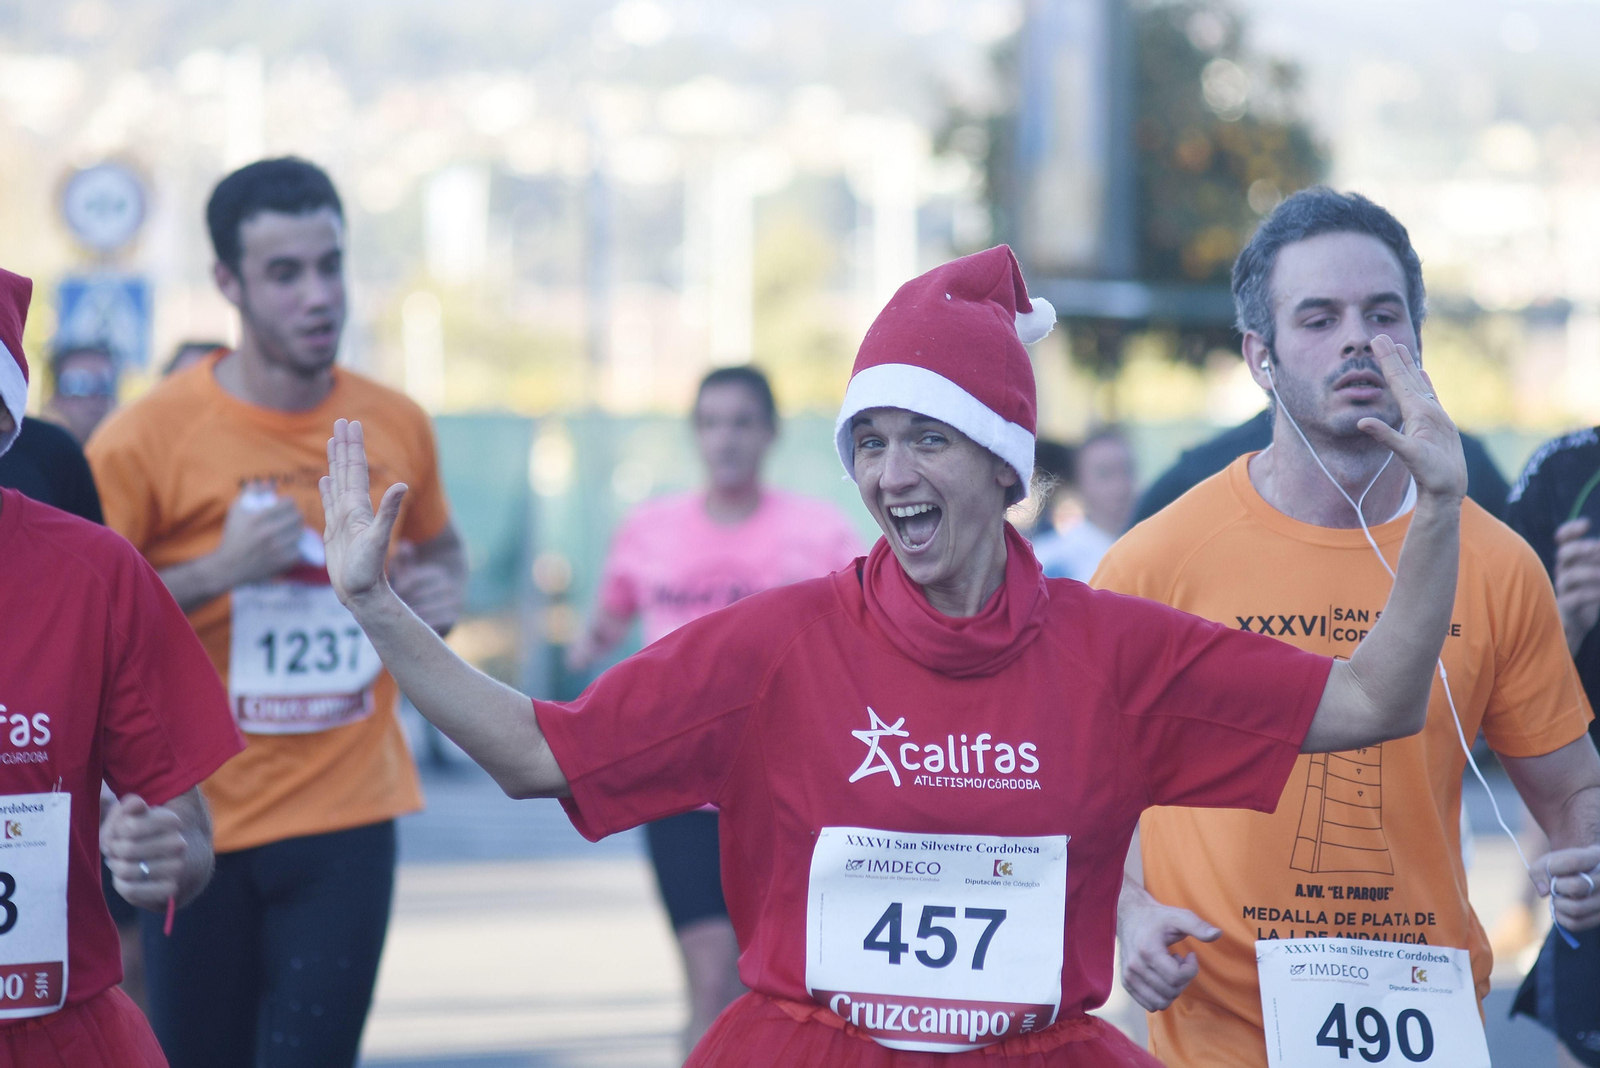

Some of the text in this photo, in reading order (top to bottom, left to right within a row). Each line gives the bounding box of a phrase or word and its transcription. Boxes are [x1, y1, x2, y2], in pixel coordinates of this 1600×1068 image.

[1235, 614, 1326, 637] XXXVI
[1333, 607, 1369, 623] SAN
[258, 627, 362, 676] 1237
[900, 733, 1040, 774] califas
[845, 834, 1040, 855] XXXVI San Silvestre Cordobesa
[867, 859, 942, 875] IMDECO
[965, 878, 1002, 886] Diputación
[1013, 880, 1041, 888] Córdoba
[1242, 905, 1437, 926] MEDALLA DE PLATA DE
[863, 902, 1007, 971] 457
[1257, 927, 1280, 940] LA
[1284, 943, 1450, 964] XXXVI San Silvestre Cordobesa
[1309, 963, 1369, 980] IMDECO
[34, 972, 49, 999] SIN
[829, 993, 1010, 1043] Cruzcampo
[1316, 1002, 1434, 1064] 490
